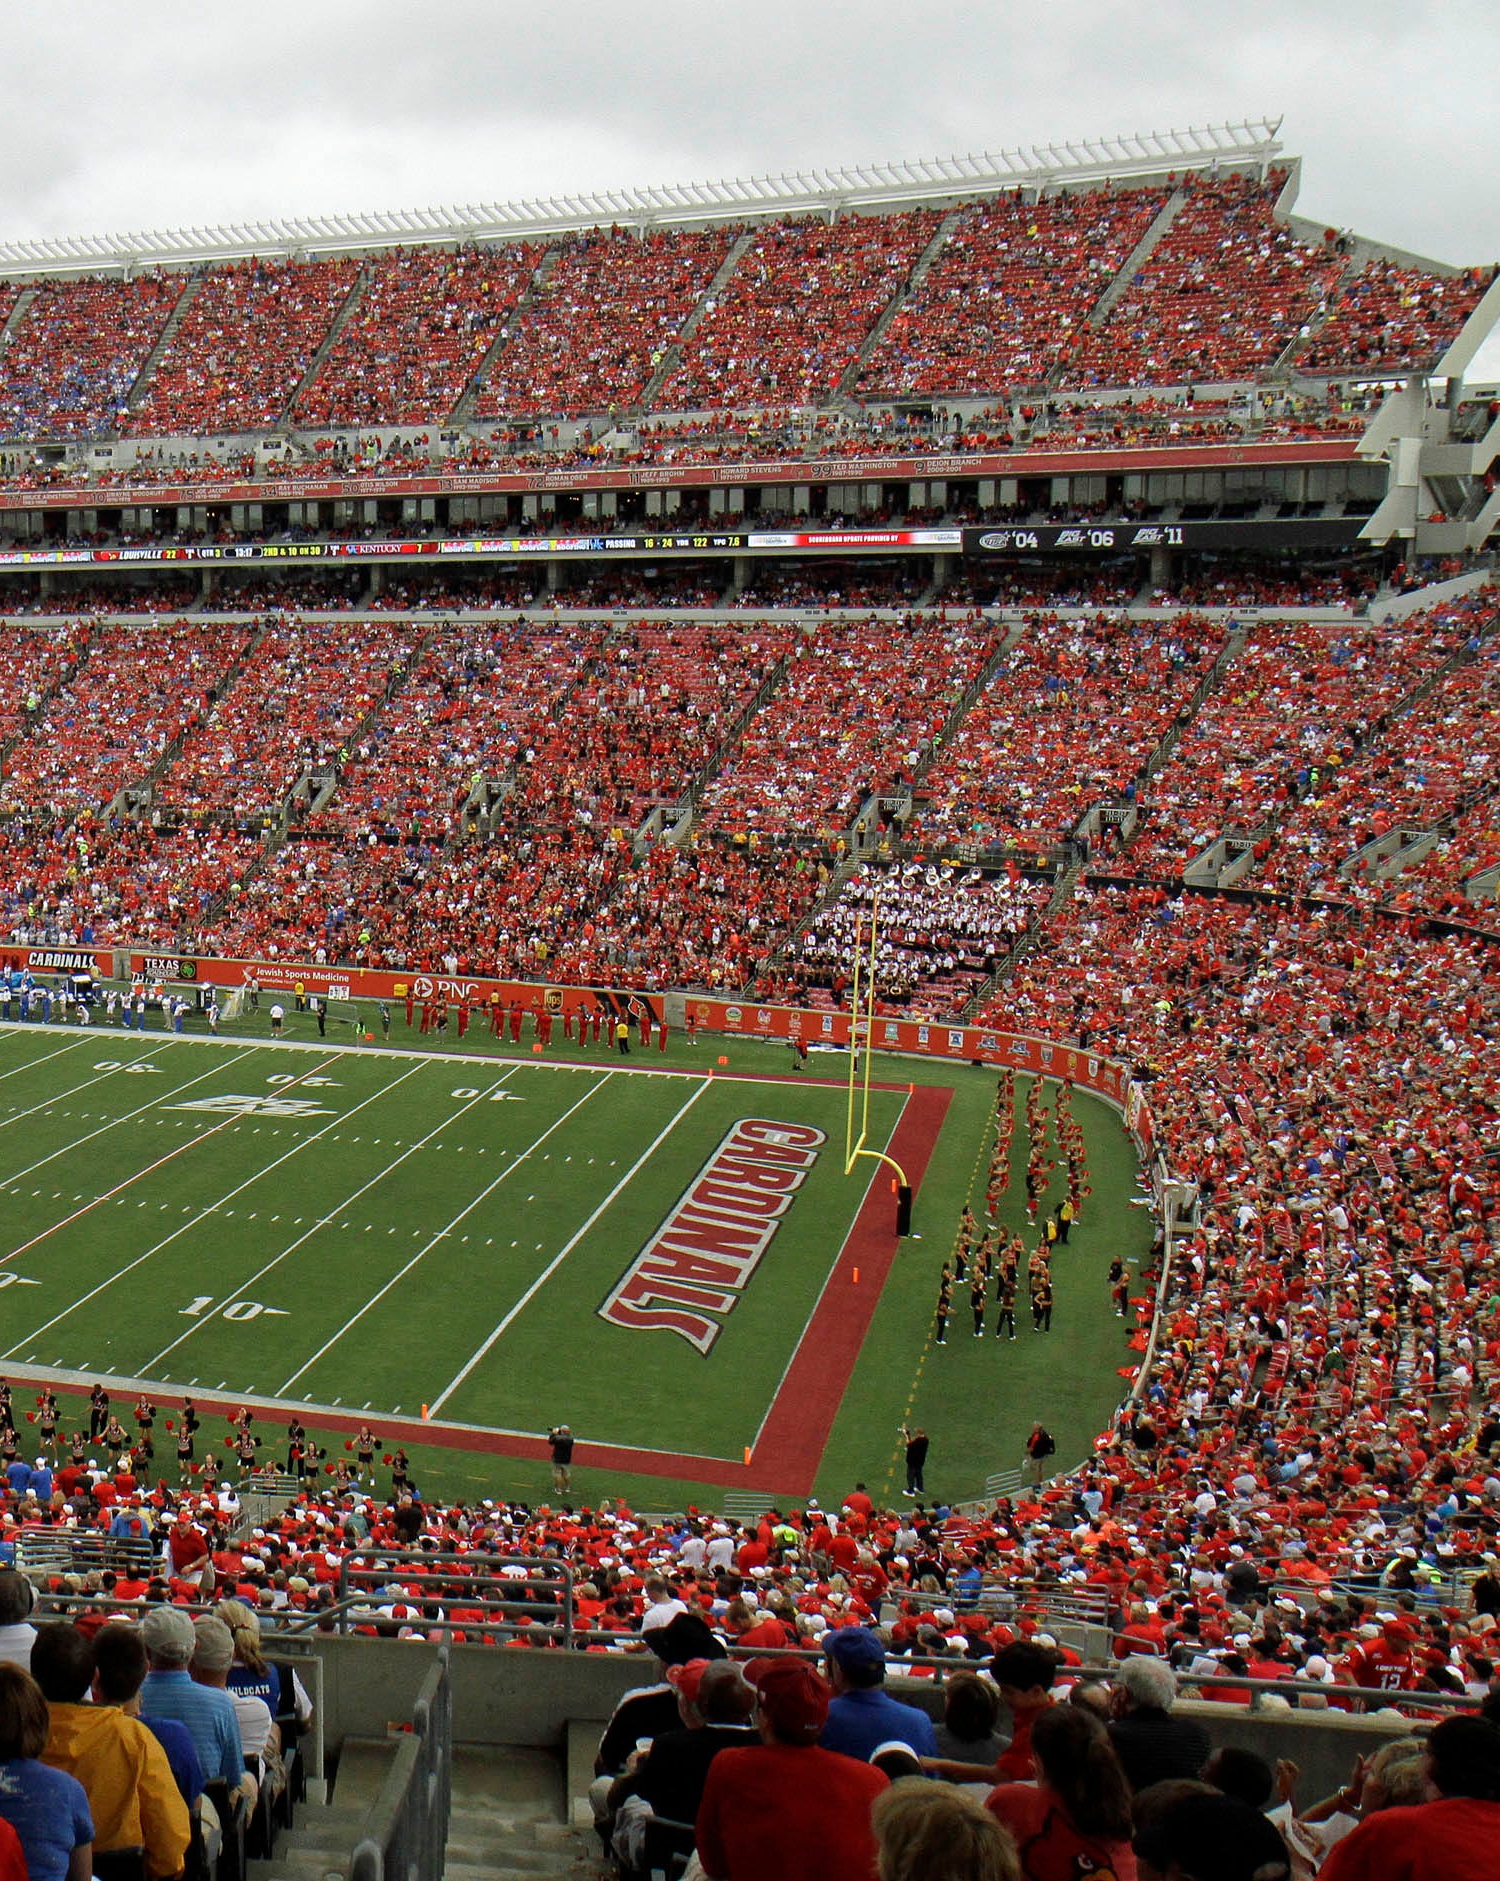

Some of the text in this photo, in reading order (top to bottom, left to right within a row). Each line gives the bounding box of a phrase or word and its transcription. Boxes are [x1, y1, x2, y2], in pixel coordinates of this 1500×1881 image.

[848, 461, 897, 469] WASHINGTON
[914, 461, 925, 474] 9
[927, 459, 949, 467] DEION
[811, 465, 831, 477] 99
[526, 477, 544, 488] 72
[628, 473, 640, 485] 11
[260, 486, 276, 497] 34
[342, 483, 359, 494] 50
[360, 544, 401, 553] KENTUCKY
[605, 540, 636, 548] PASSING
[644, 539, 654, 548] 16
[661, 538, 673, 547] 24
[693, 537, 707, 547] 122
[119, 549, 176, 559] LOUISVILLE 22
[263, 547, 278, 557] 2ND
[288, 546, 297, 555] 10
[310, 546, 321, 555] 30
[28, 952, 96, 969] CARDINALS
[145, 957, 180, 969] TEXAS
[257, 967, 350, 982] Jewish Sports Medicine
[438, 981, 480, 1001] PNC
[547, 991, 562, 1006] ups
[266, 1073, 333, 1087] 20
[596, 1117, 829, 1358] CARDINALS
[178, 1295, 266, 1322] 10
[1380, 1672, 1401, 1691] 12
